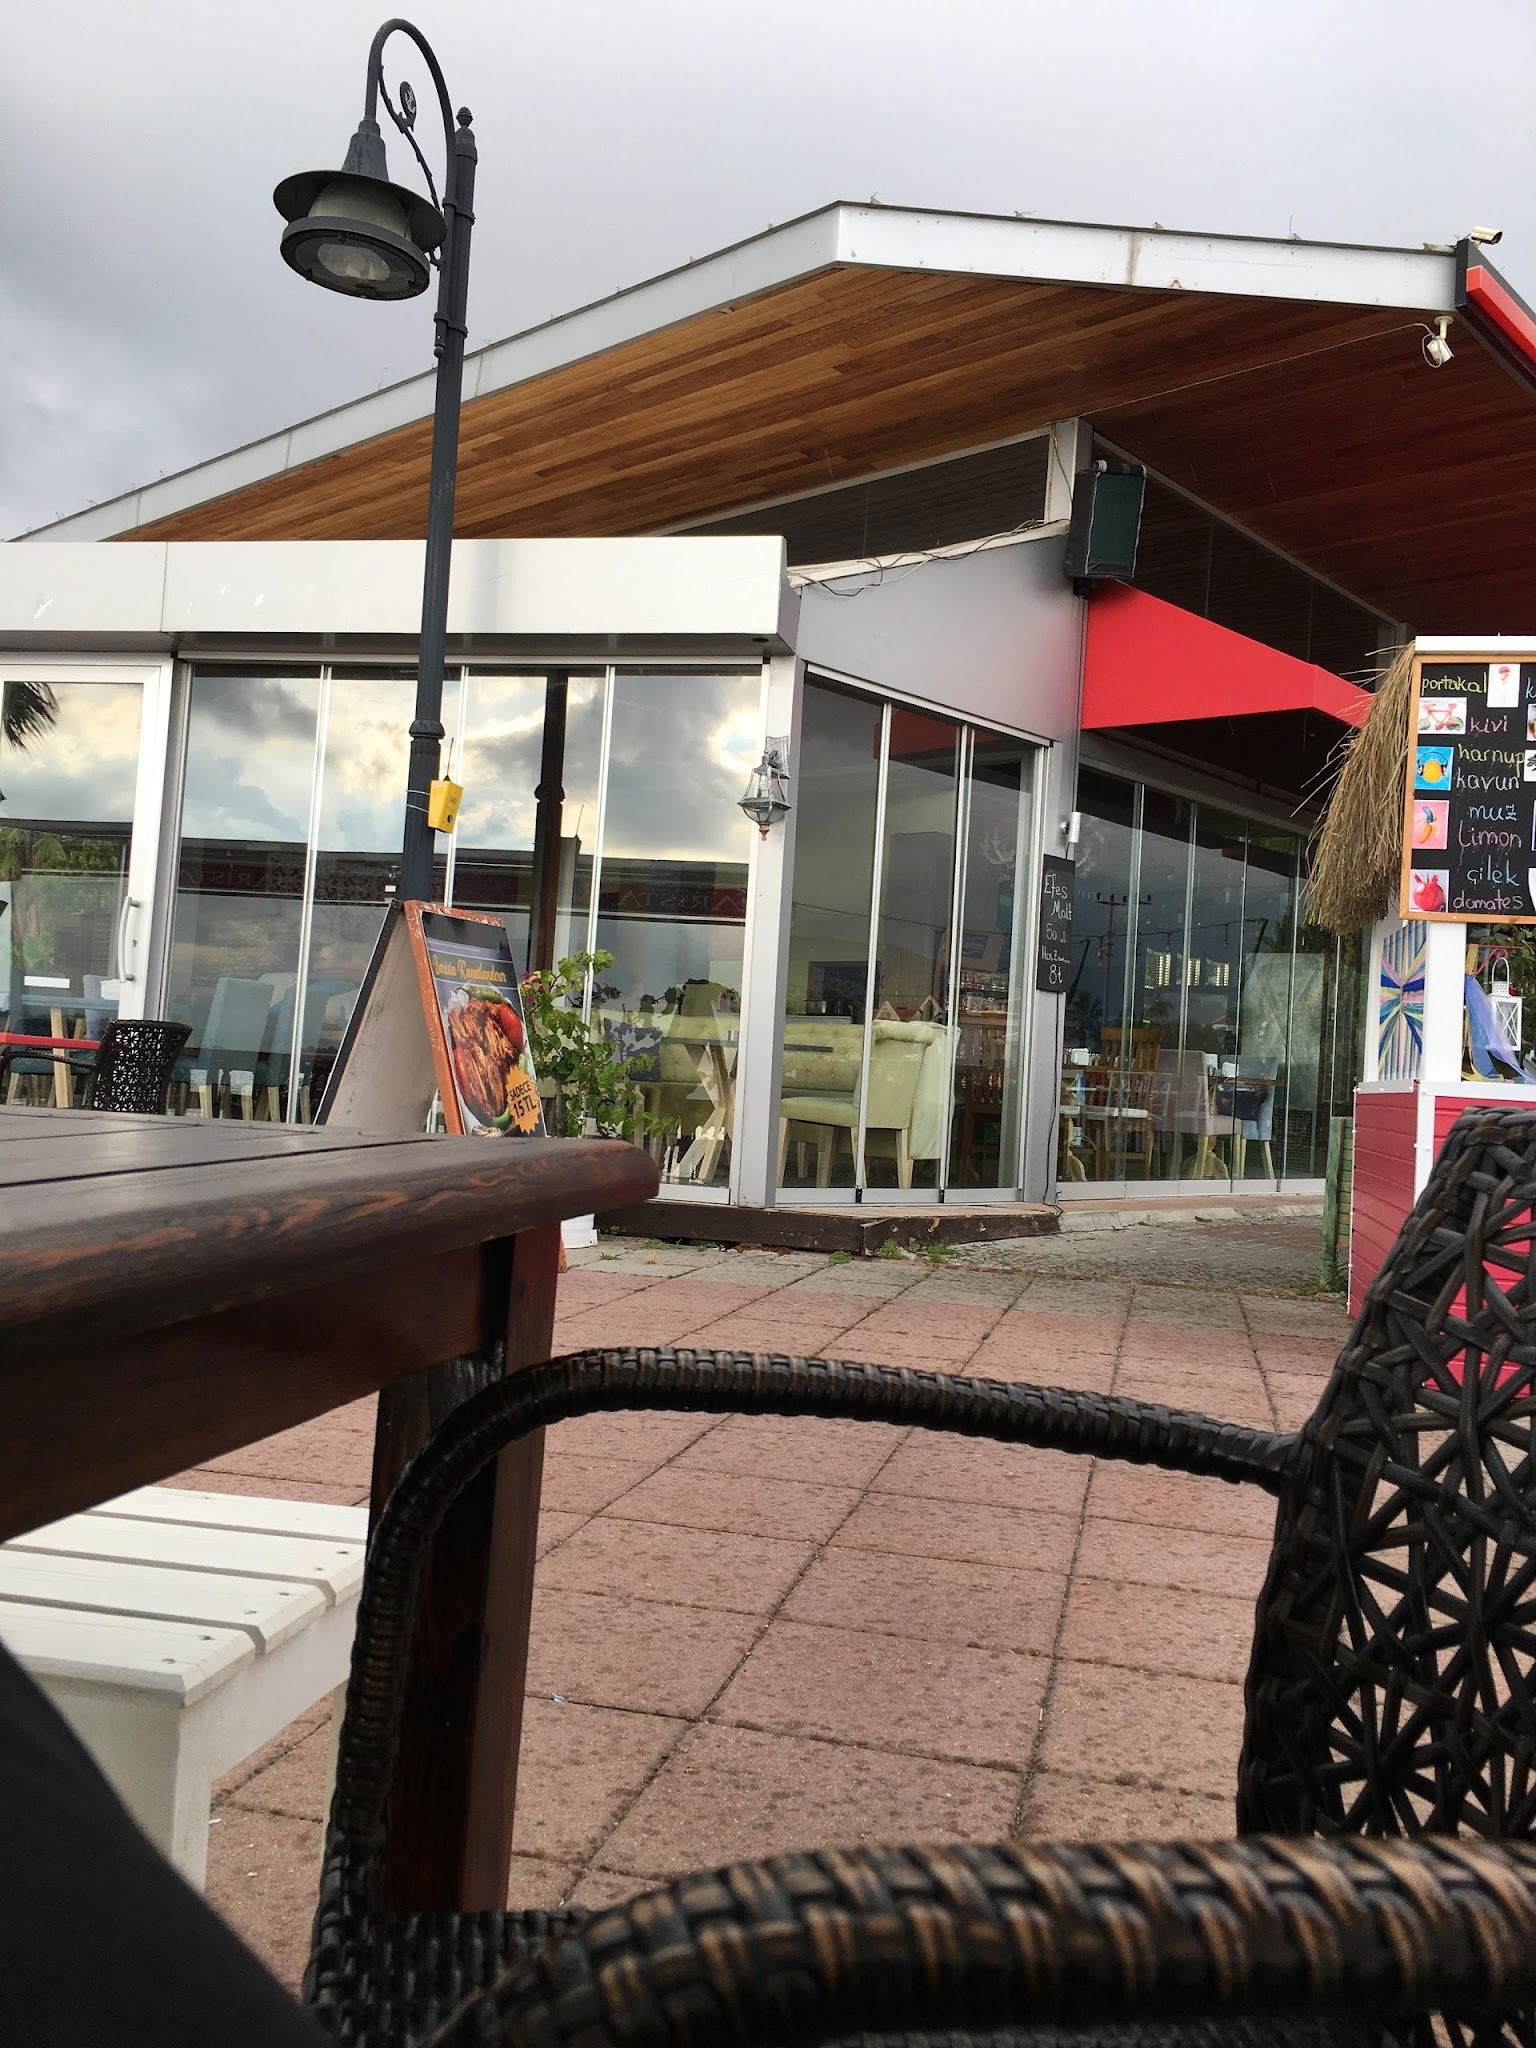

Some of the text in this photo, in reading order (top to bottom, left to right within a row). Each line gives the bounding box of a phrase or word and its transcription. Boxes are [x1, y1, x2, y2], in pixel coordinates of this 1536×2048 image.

[1421, 671, 1487, 696] portakal
[1470, 715, 1508, 733] kivi
[1457, 743, 1525, 778] harnup
[1456, 766, 1519, 791] kavun
[1469, 804, 1518, 821] muz
[1466, 854, 1520, 886] çilek
[1044, 873, 1067, 899] Efes
[1050, 900, 1072, 920] Malt
[1453, 889, 1523, 911] domates
[509, 1080, 531, 1102] SADECE
